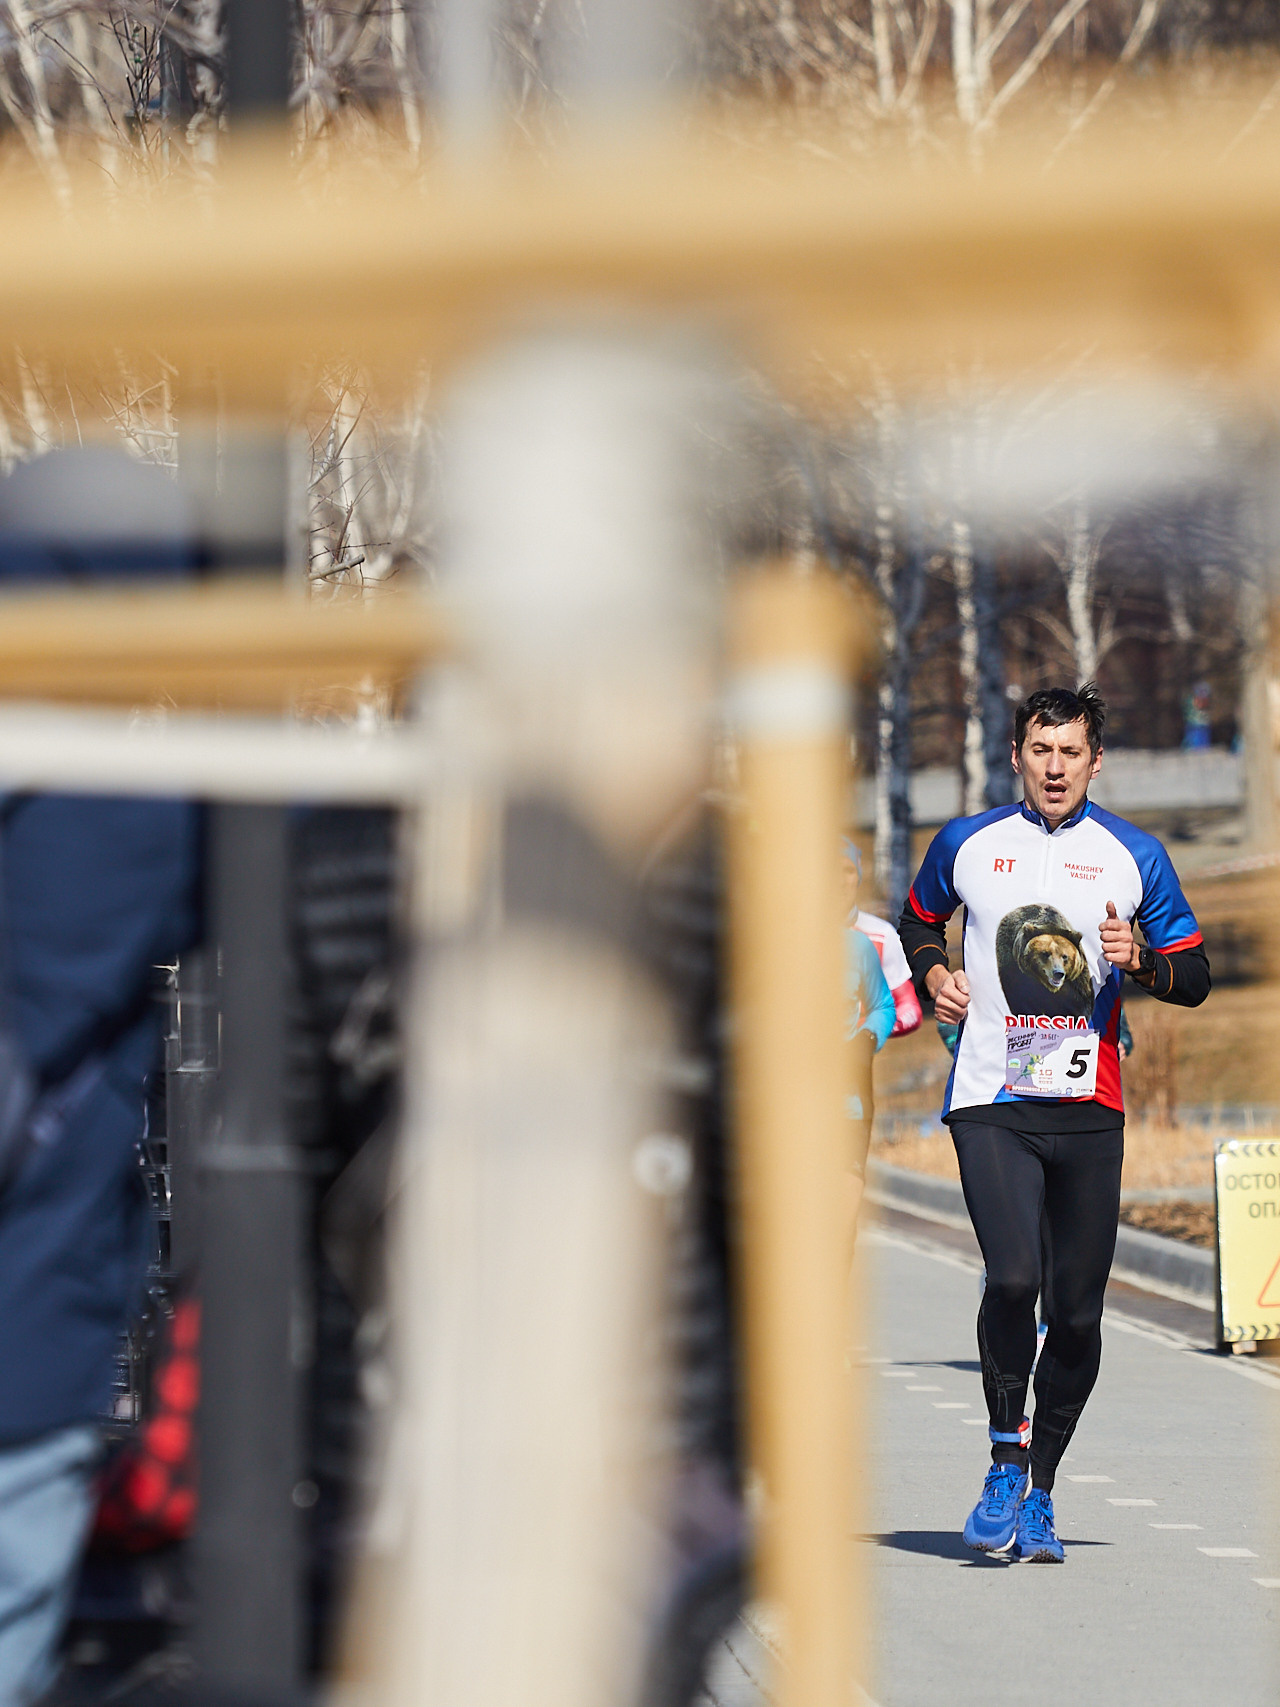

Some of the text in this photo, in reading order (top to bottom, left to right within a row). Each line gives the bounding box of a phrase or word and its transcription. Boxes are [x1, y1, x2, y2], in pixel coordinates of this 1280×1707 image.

[993, 858, 1017, 873] RT
[1064, 862, 1104, 874] MAKUSHEV
[1070, 871, 1097, 881] VASILIY
[1065, 1049, 1092, 1079] 5
